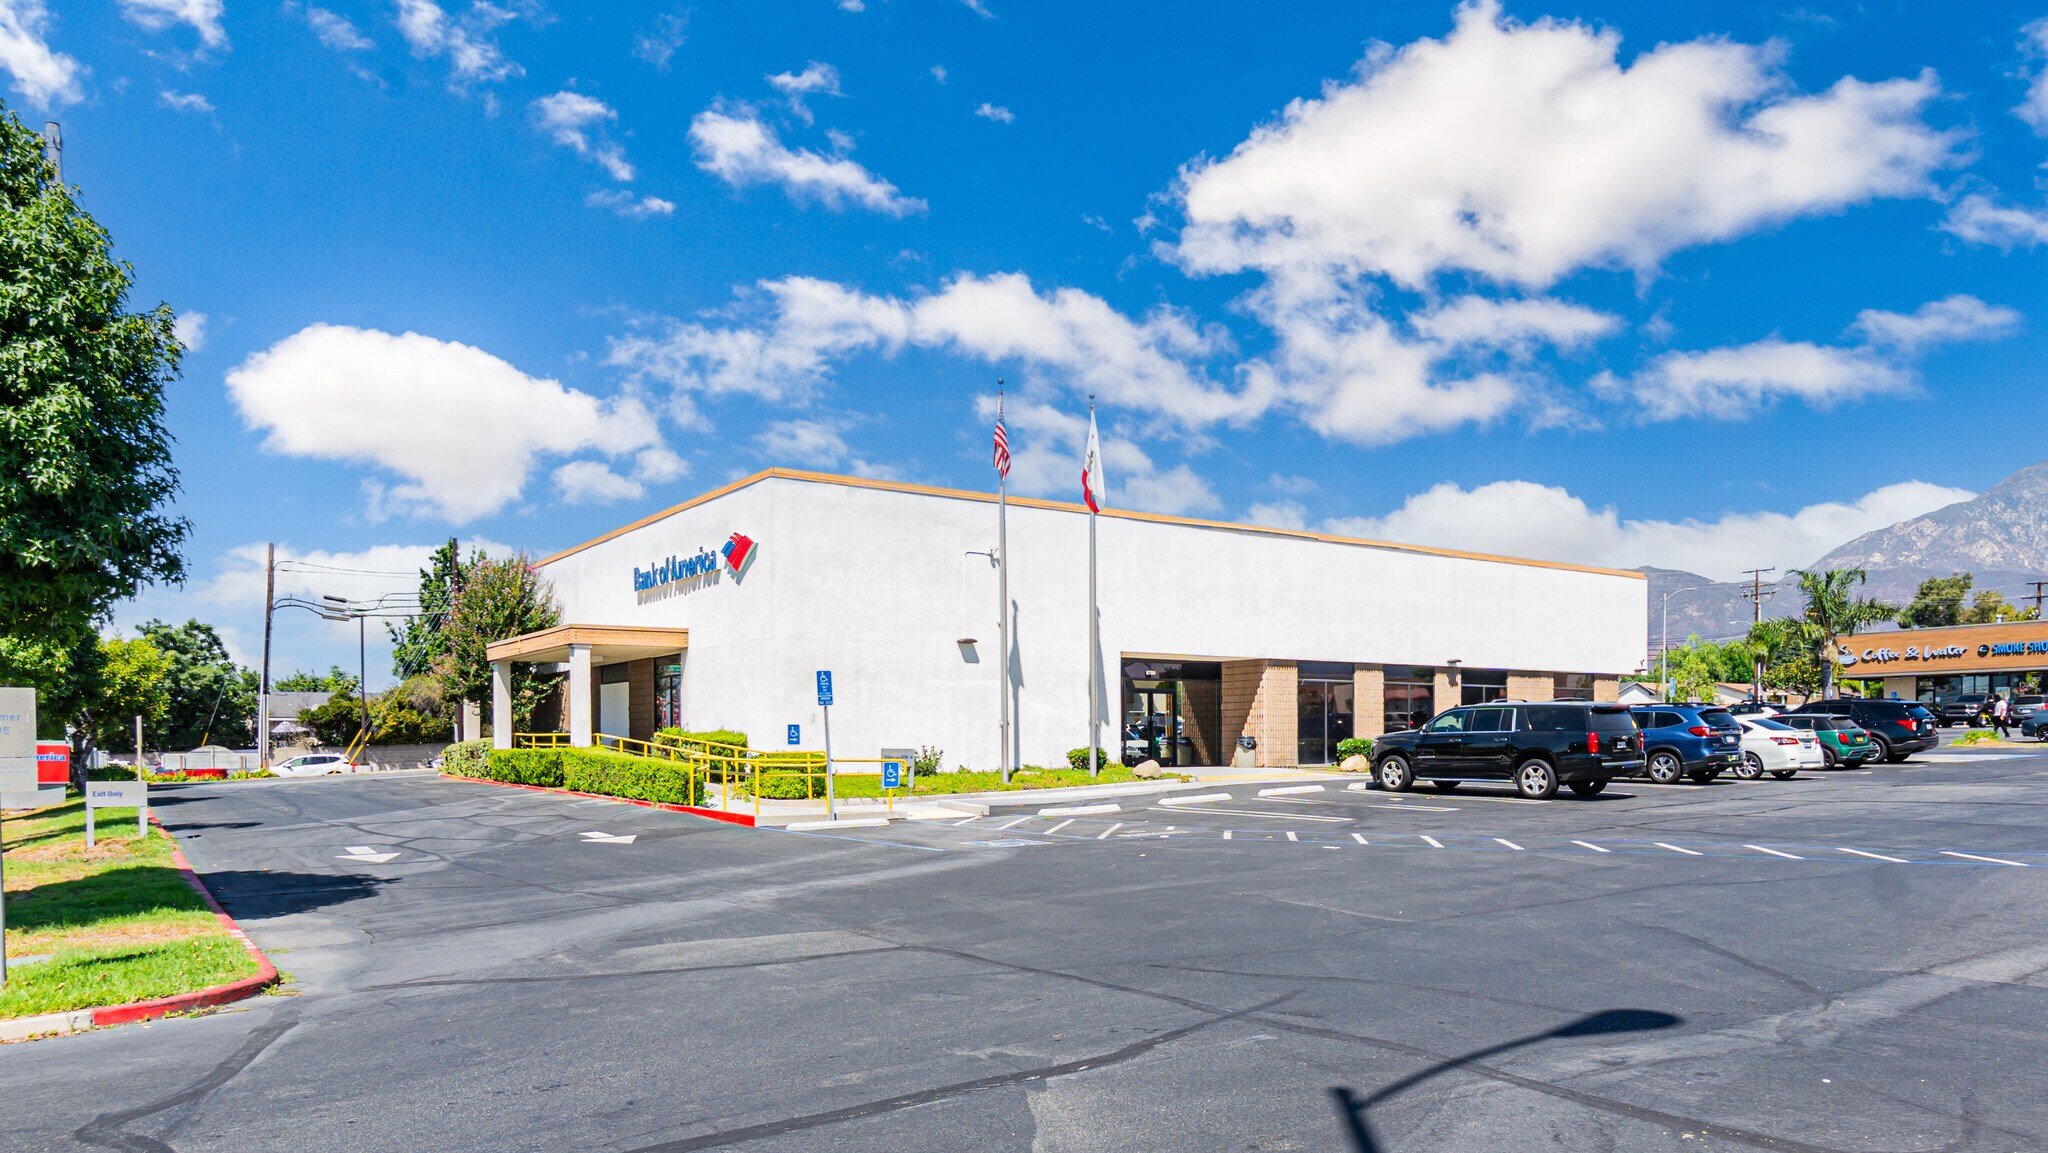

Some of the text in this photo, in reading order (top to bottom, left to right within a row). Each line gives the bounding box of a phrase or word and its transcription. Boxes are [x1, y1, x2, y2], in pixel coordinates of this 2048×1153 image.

[634, 546, 717, 591] Bank of America
[1861, 644, 1967, 661] Coffee & Water
[1992, 642, 2025, 655] SMOKE
[36, 752, 66, 762] erica
[107, 790, 123, 798] Only
